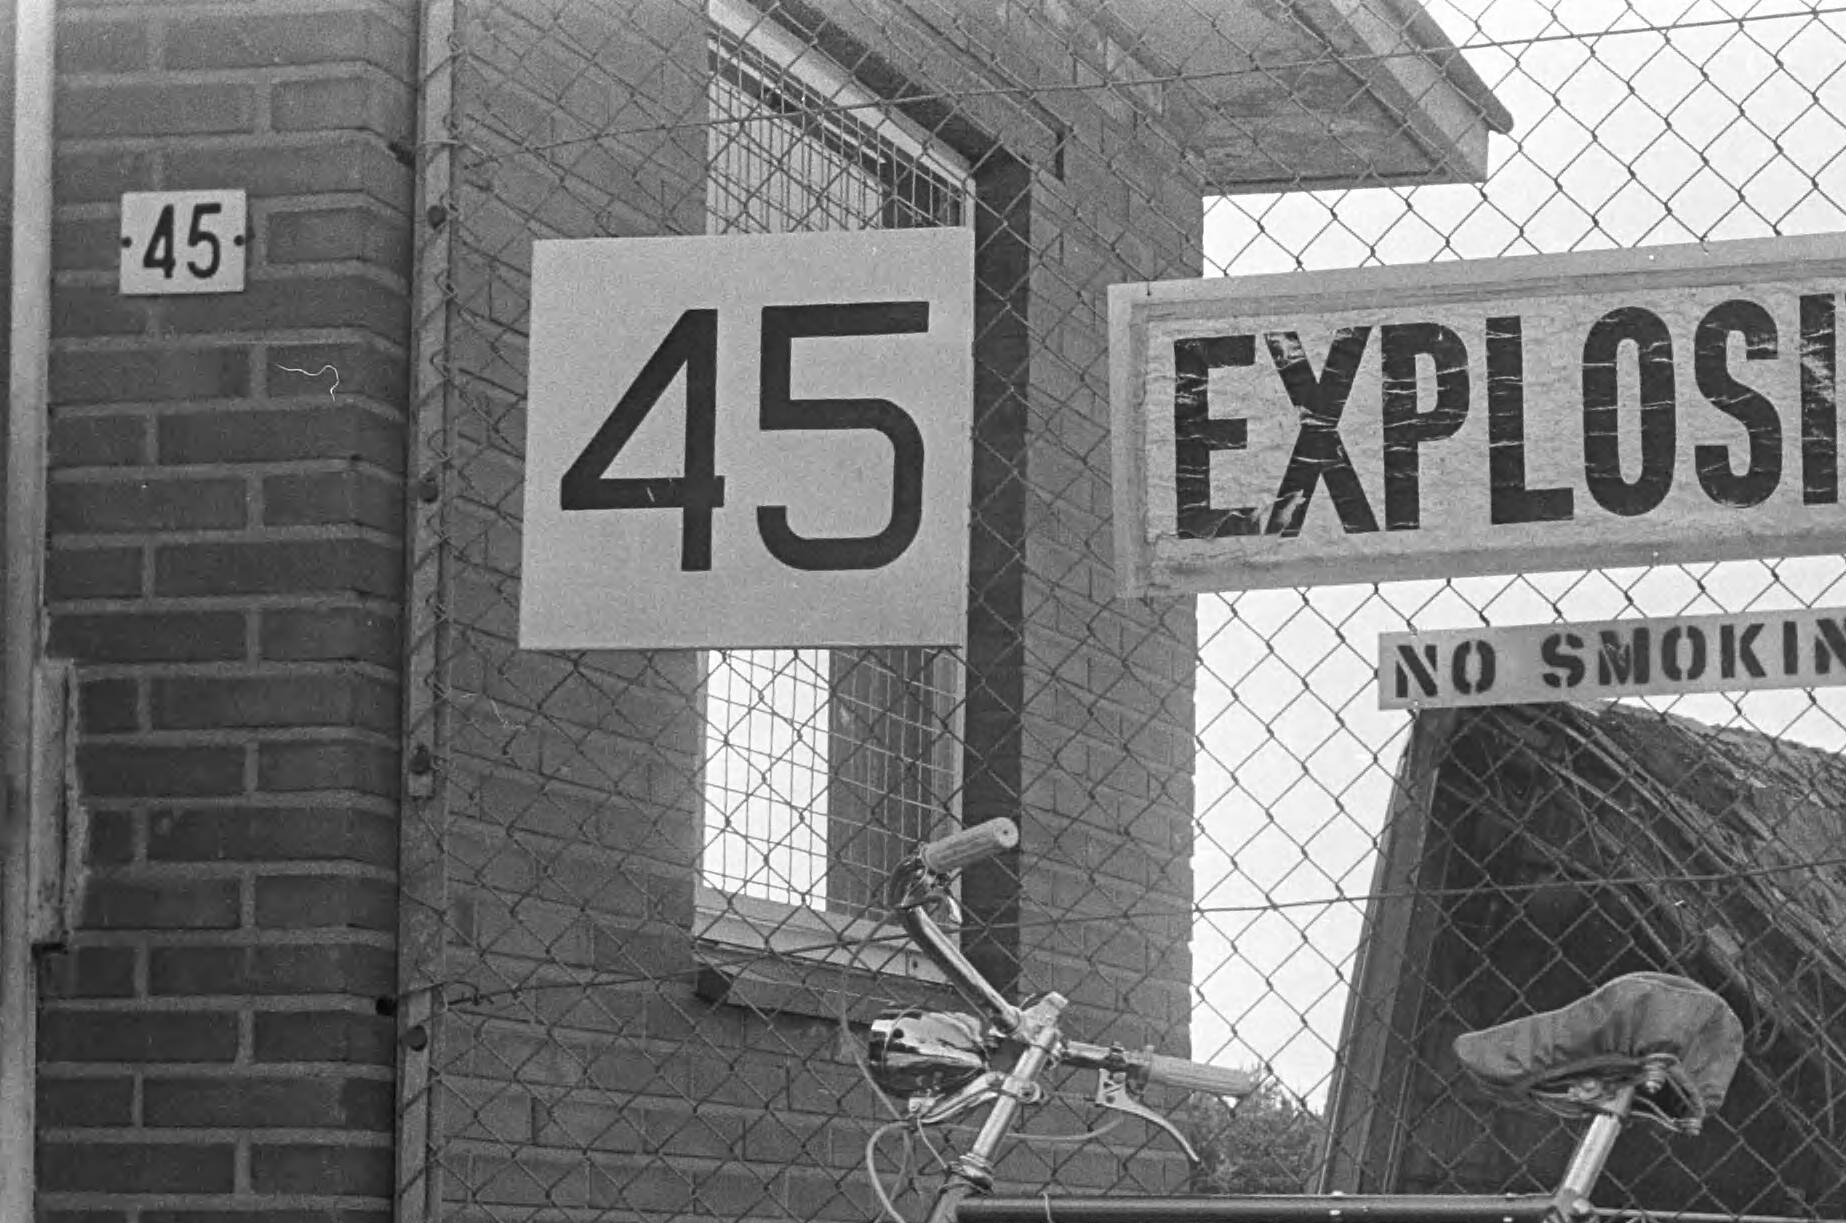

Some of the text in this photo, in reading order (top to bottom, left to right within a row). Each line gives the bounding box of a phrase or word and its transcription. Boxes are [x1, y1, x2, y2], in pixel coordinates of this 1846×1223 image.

[142, 202, 222, 280] 45
[559, 301, 930, 572] 45
[1395, 639, 1496, 698] NO
